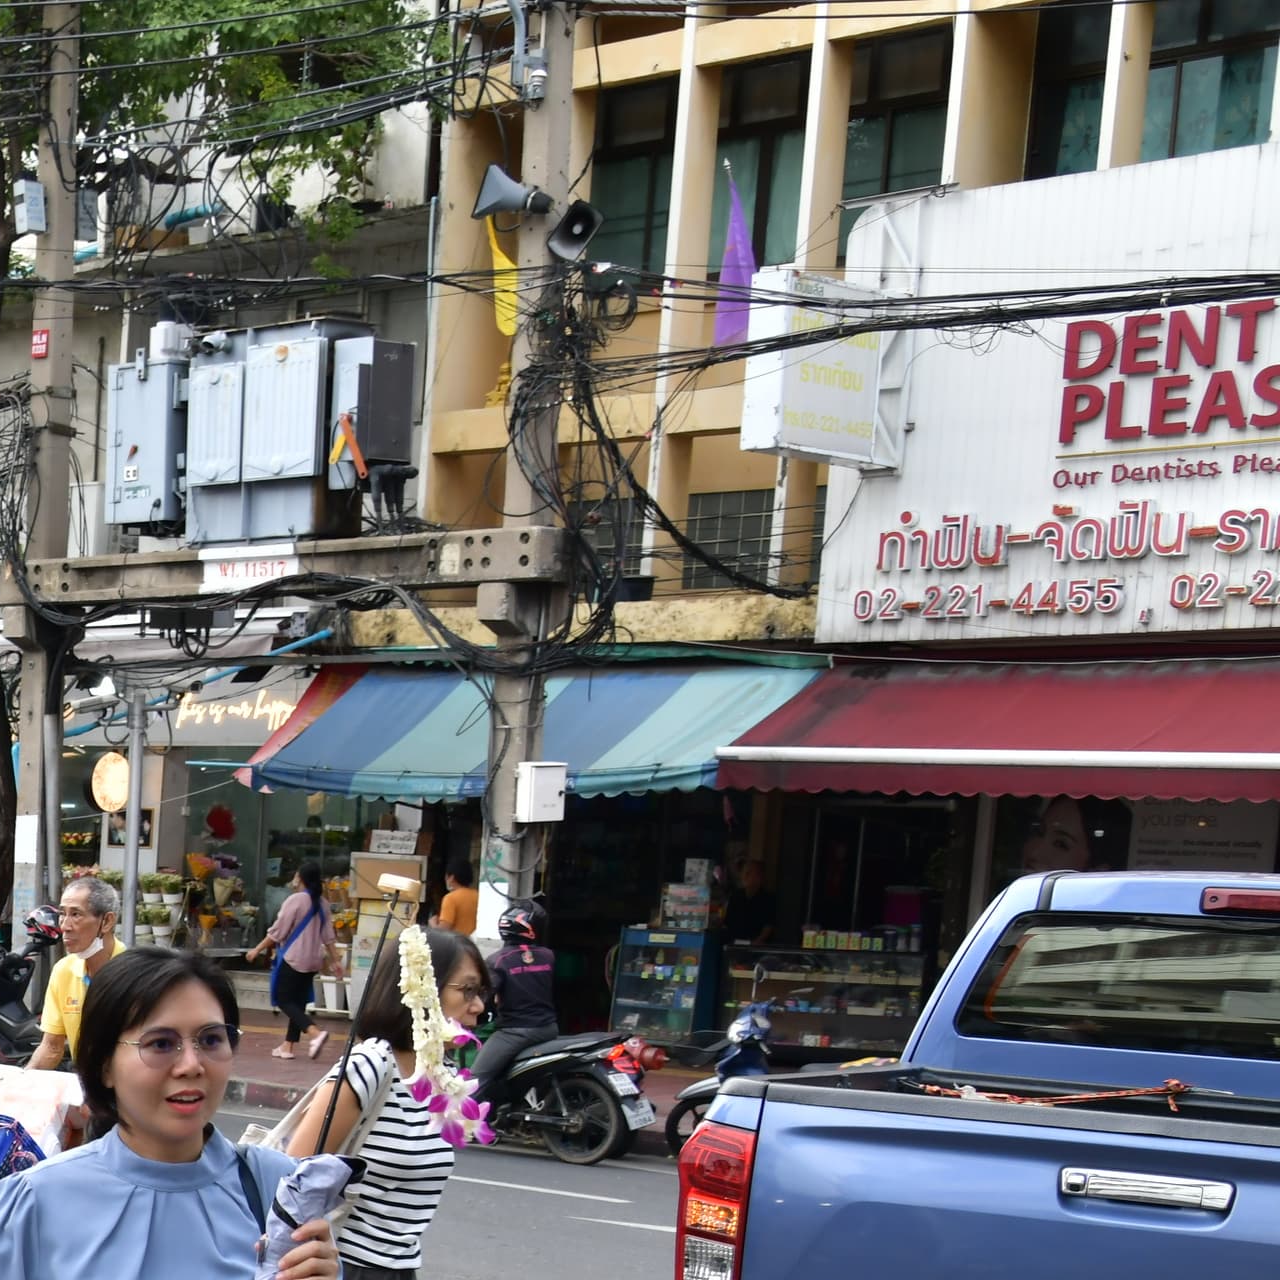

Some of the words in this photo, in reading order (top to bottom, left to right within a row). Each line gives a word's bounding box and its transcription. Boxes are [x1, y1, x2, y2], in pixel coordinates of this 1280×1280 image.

[1052, 469, 1104, 489] Our
[1111, 456, 1223, 484] Dentists
[877, 500, 1280, 573] ทำฟัน-จัดฟัน-รา
[244, 560, 288, 578] 11517
[1168, 569, 1280, 610] 02-2
[208, 703, 227, 724] is
